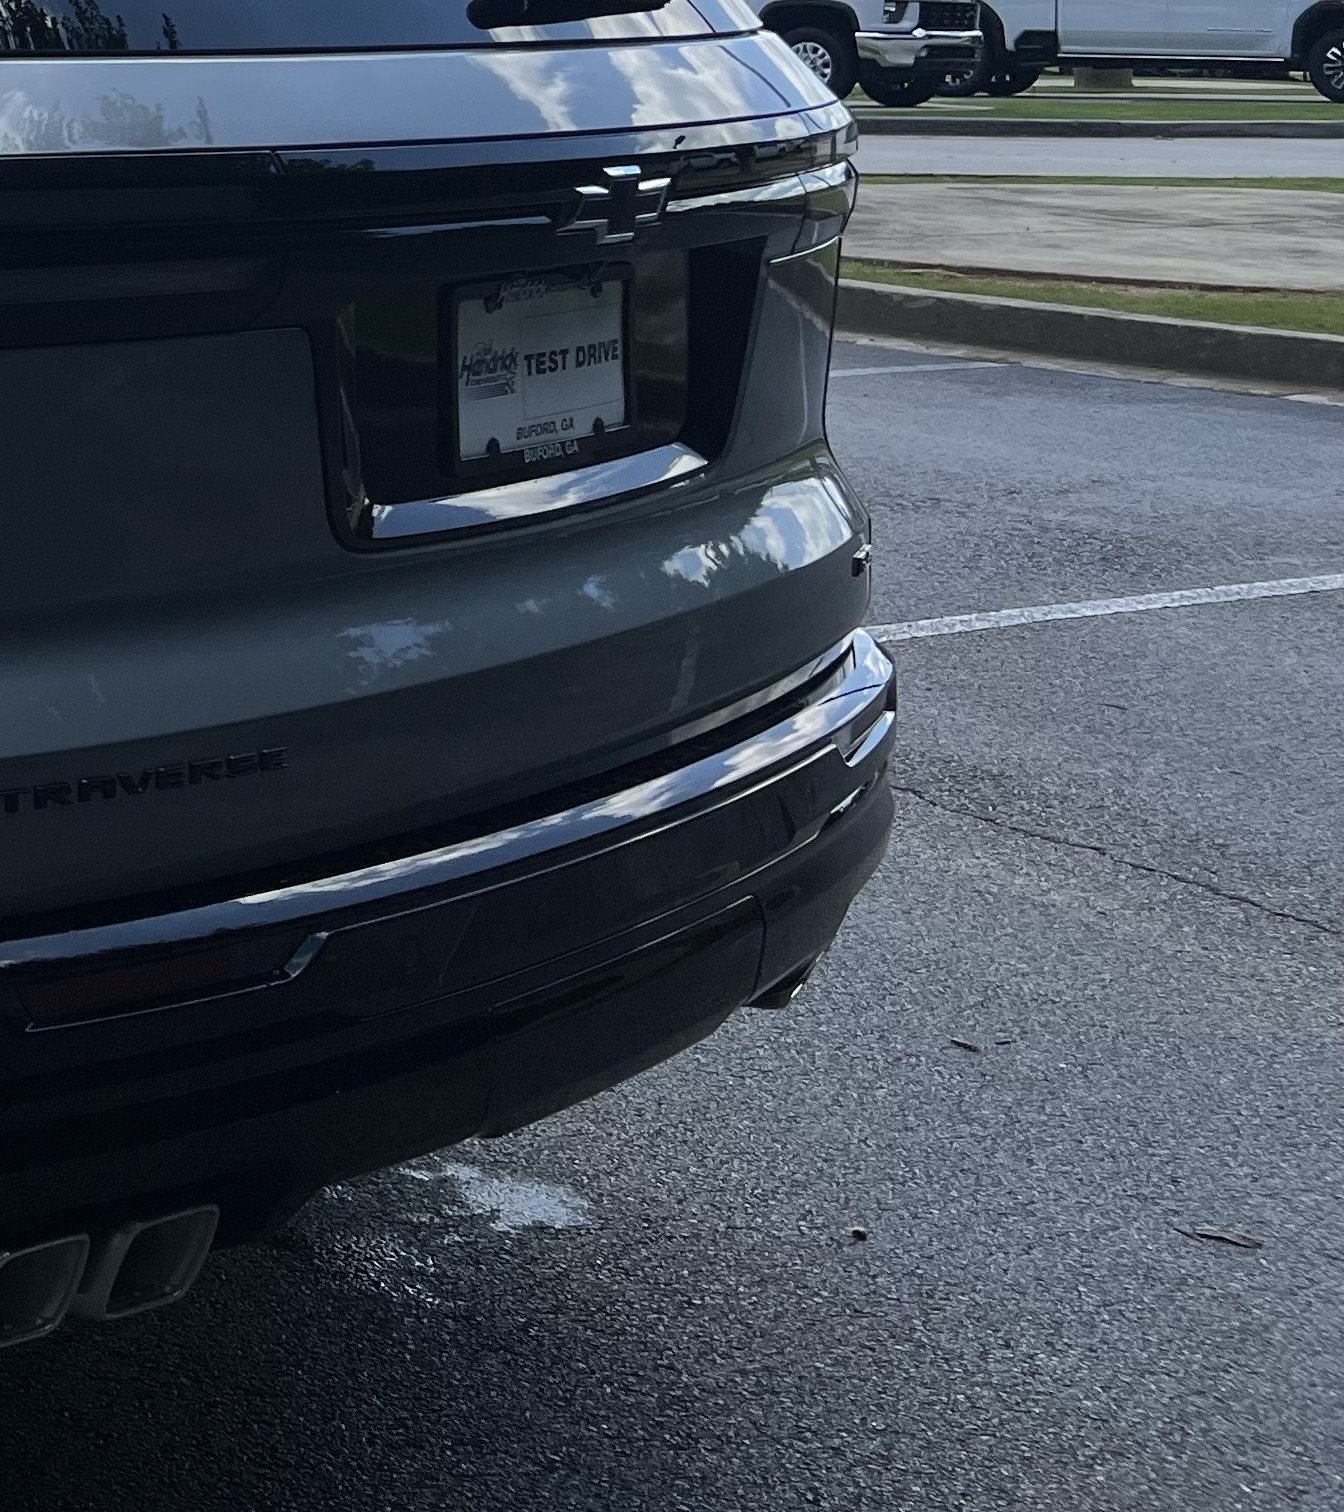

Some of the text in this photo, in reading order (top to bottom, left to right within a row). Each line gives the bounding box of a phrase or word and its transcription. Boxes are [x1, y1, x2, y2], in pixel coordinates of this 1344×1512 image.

[523, 348, 570, 376] TEST
[575, 339, 619, 369] DRIVE
[560, 417, 575, 431] GA
[565, 439, 580, 455] GA
